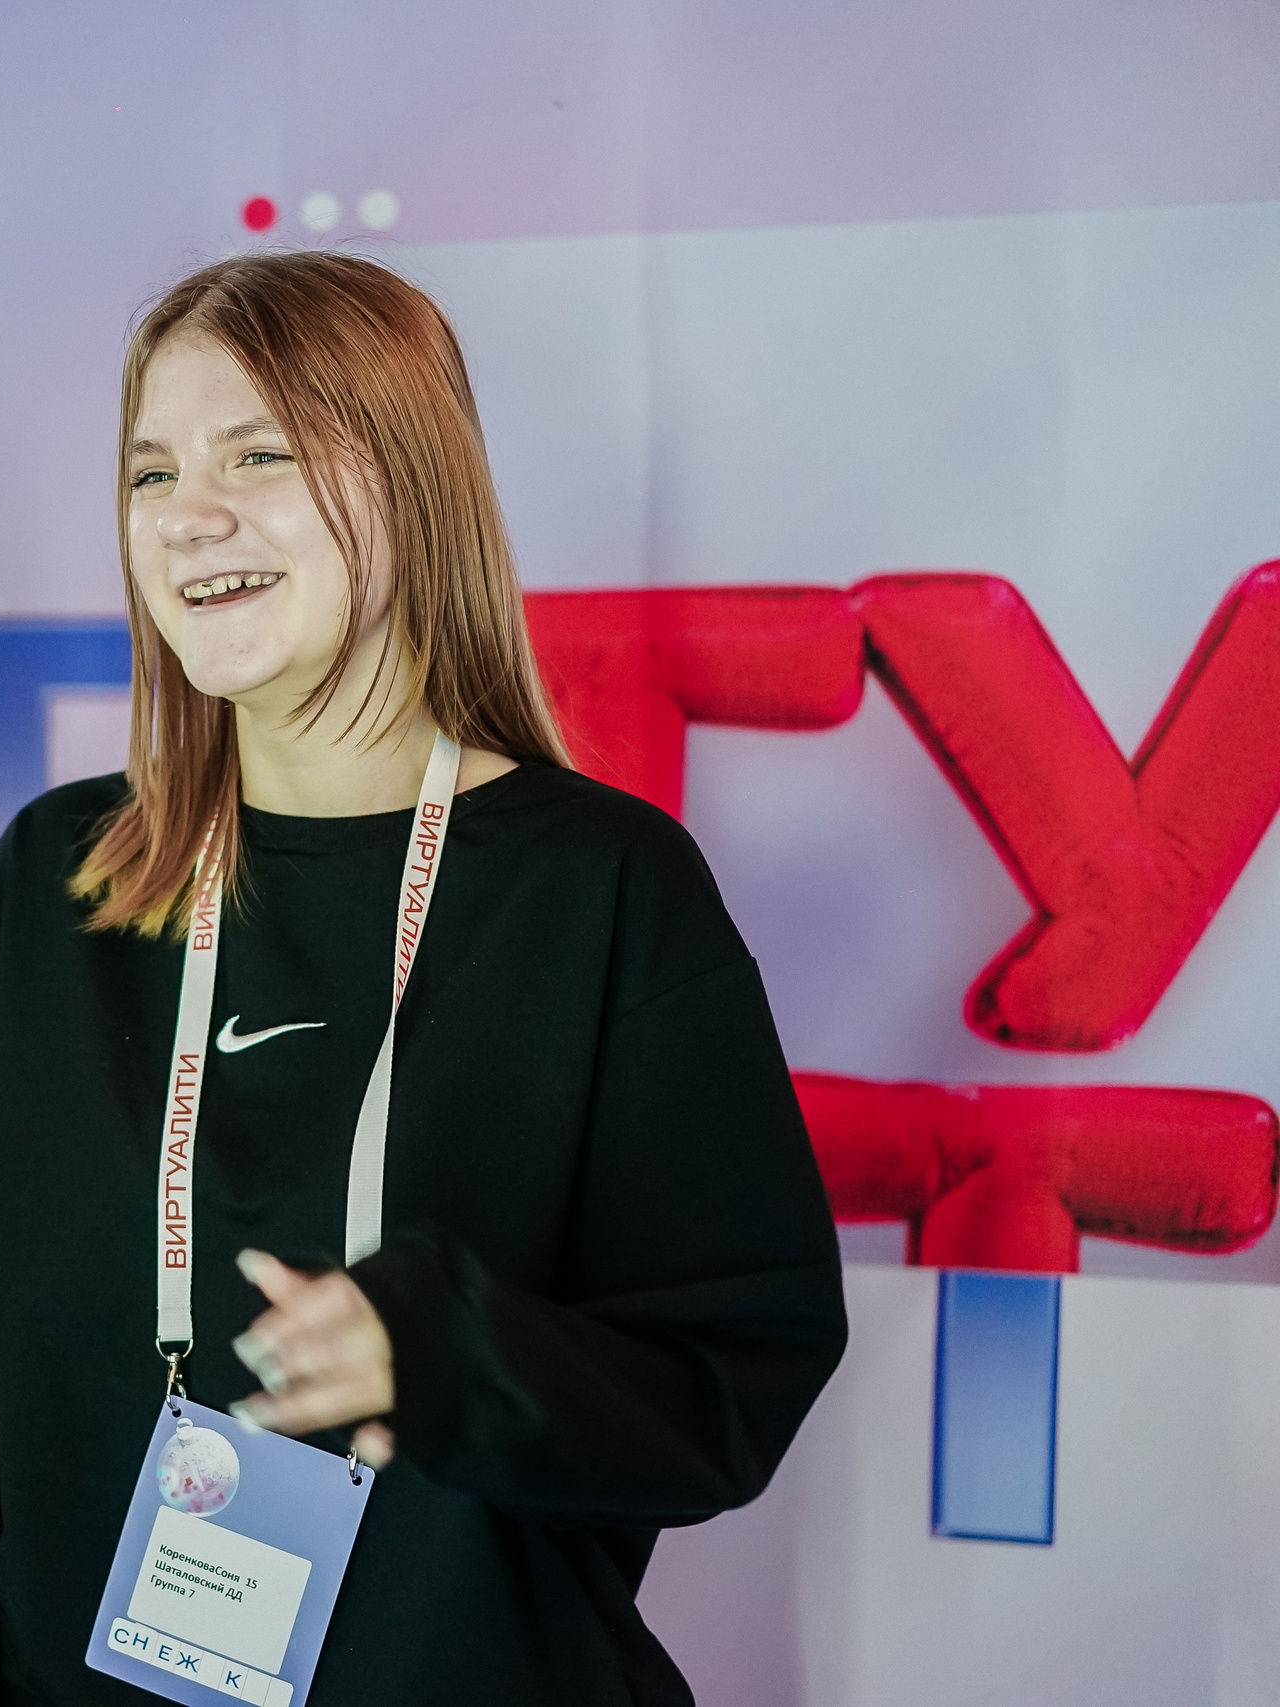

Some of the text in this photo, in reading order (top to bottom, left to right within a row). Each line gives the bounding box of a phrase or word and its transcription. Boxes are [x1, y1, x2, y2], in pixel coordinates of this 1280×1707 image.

[165, 1053, 200, 1269] ВИРТУАЛИТИ
[150, 1574, 196, 1598] Группа 7
[155, 1559, 243, 1603] Шаталовский ДД
[245, 1577, 258, 1589] 15
